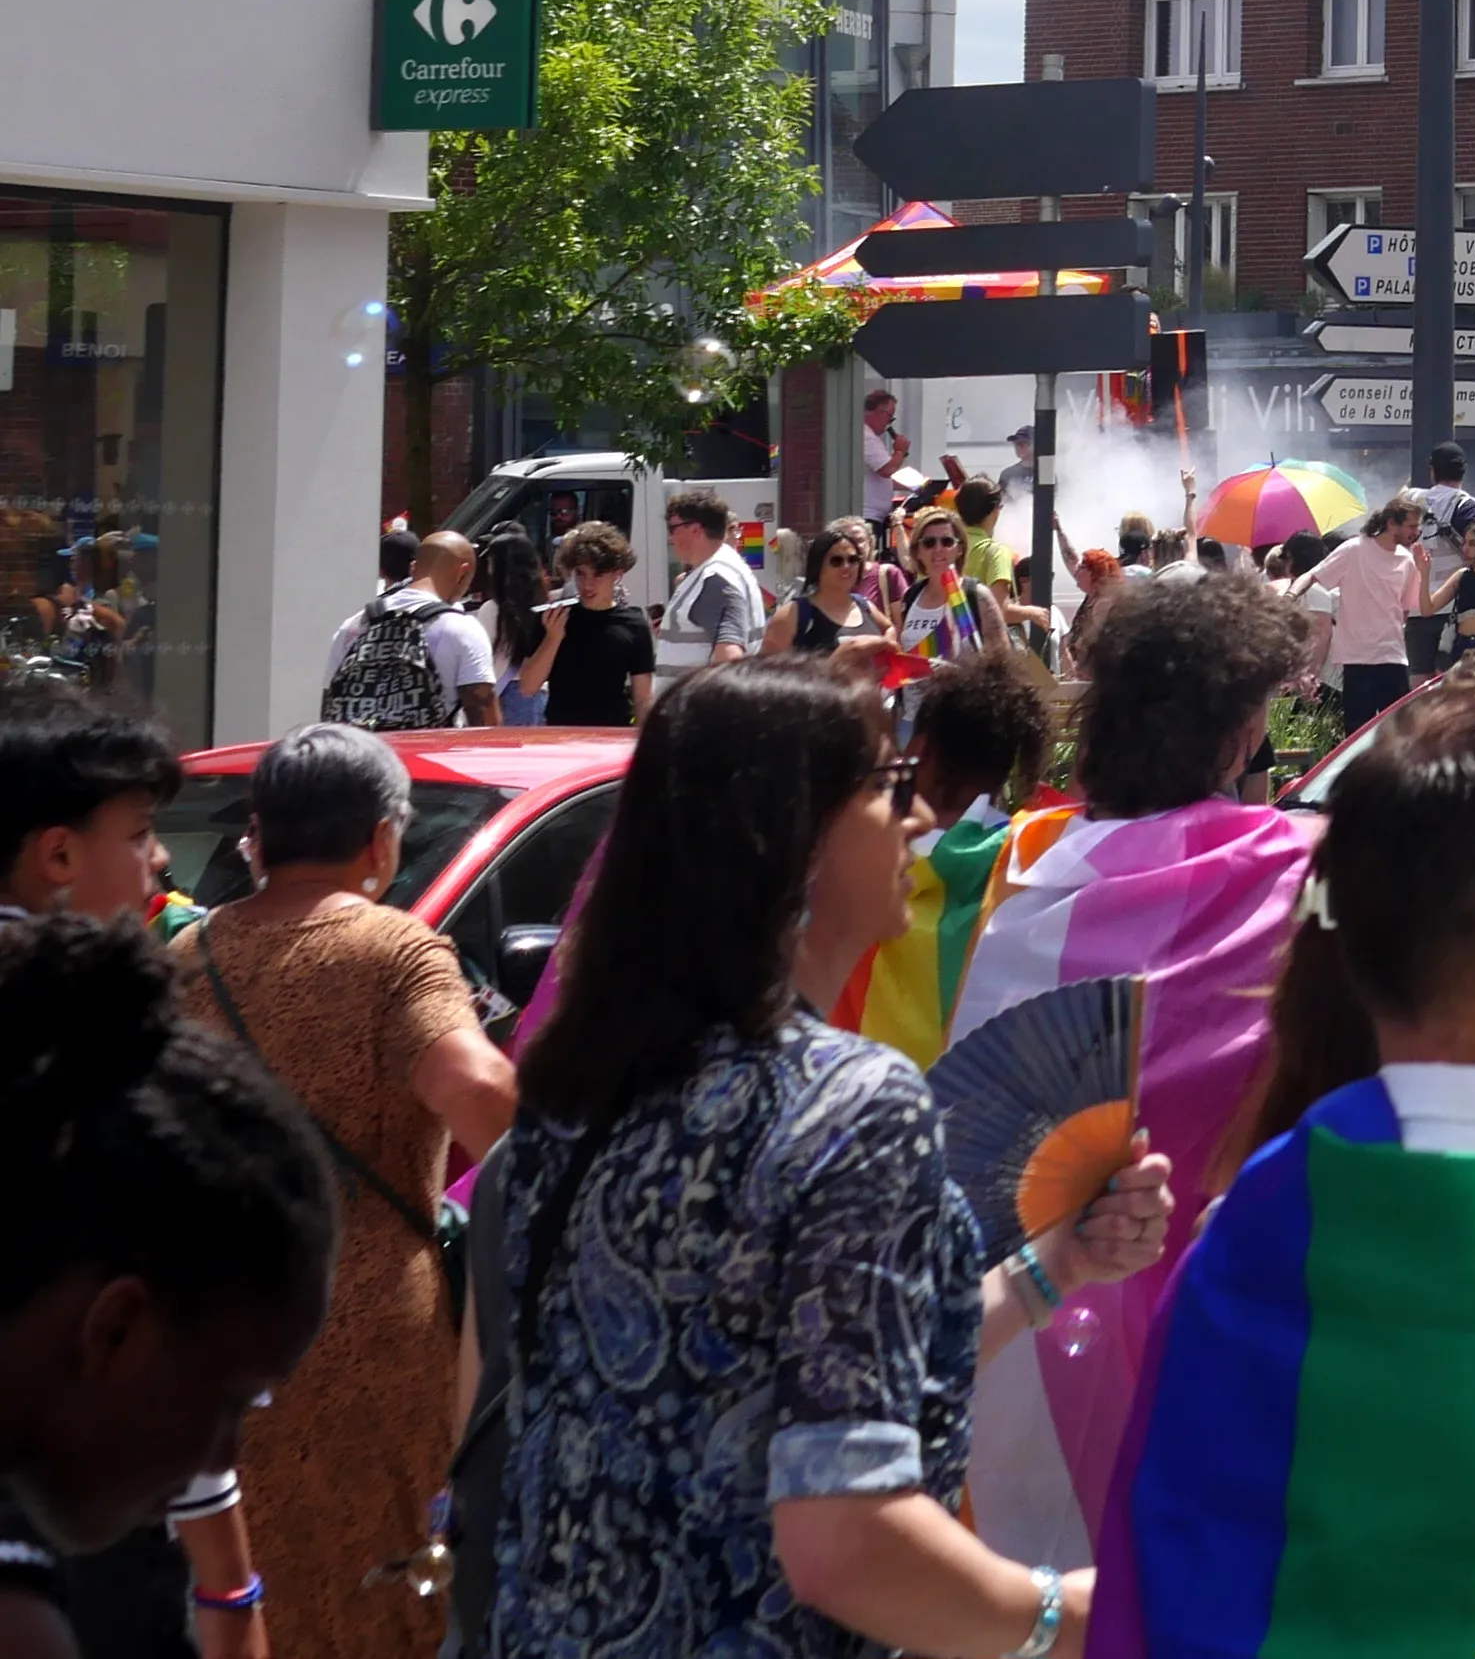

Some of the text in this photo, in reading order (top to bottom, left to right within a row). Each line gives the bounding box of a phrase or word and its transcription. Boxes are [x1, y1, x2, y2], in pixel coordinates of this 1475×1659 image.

[400, 56, 506, 81] Carrefour
[414, 87, 491, 112] express
[1369, 237, 1382, 252] P
[1388, 234, 1416, 253] HÔT
[1357, 278, 1369, 294] P
[1339, 385, 1394, 401] conseil
[1339, 405, 1413, 420] de la Som
